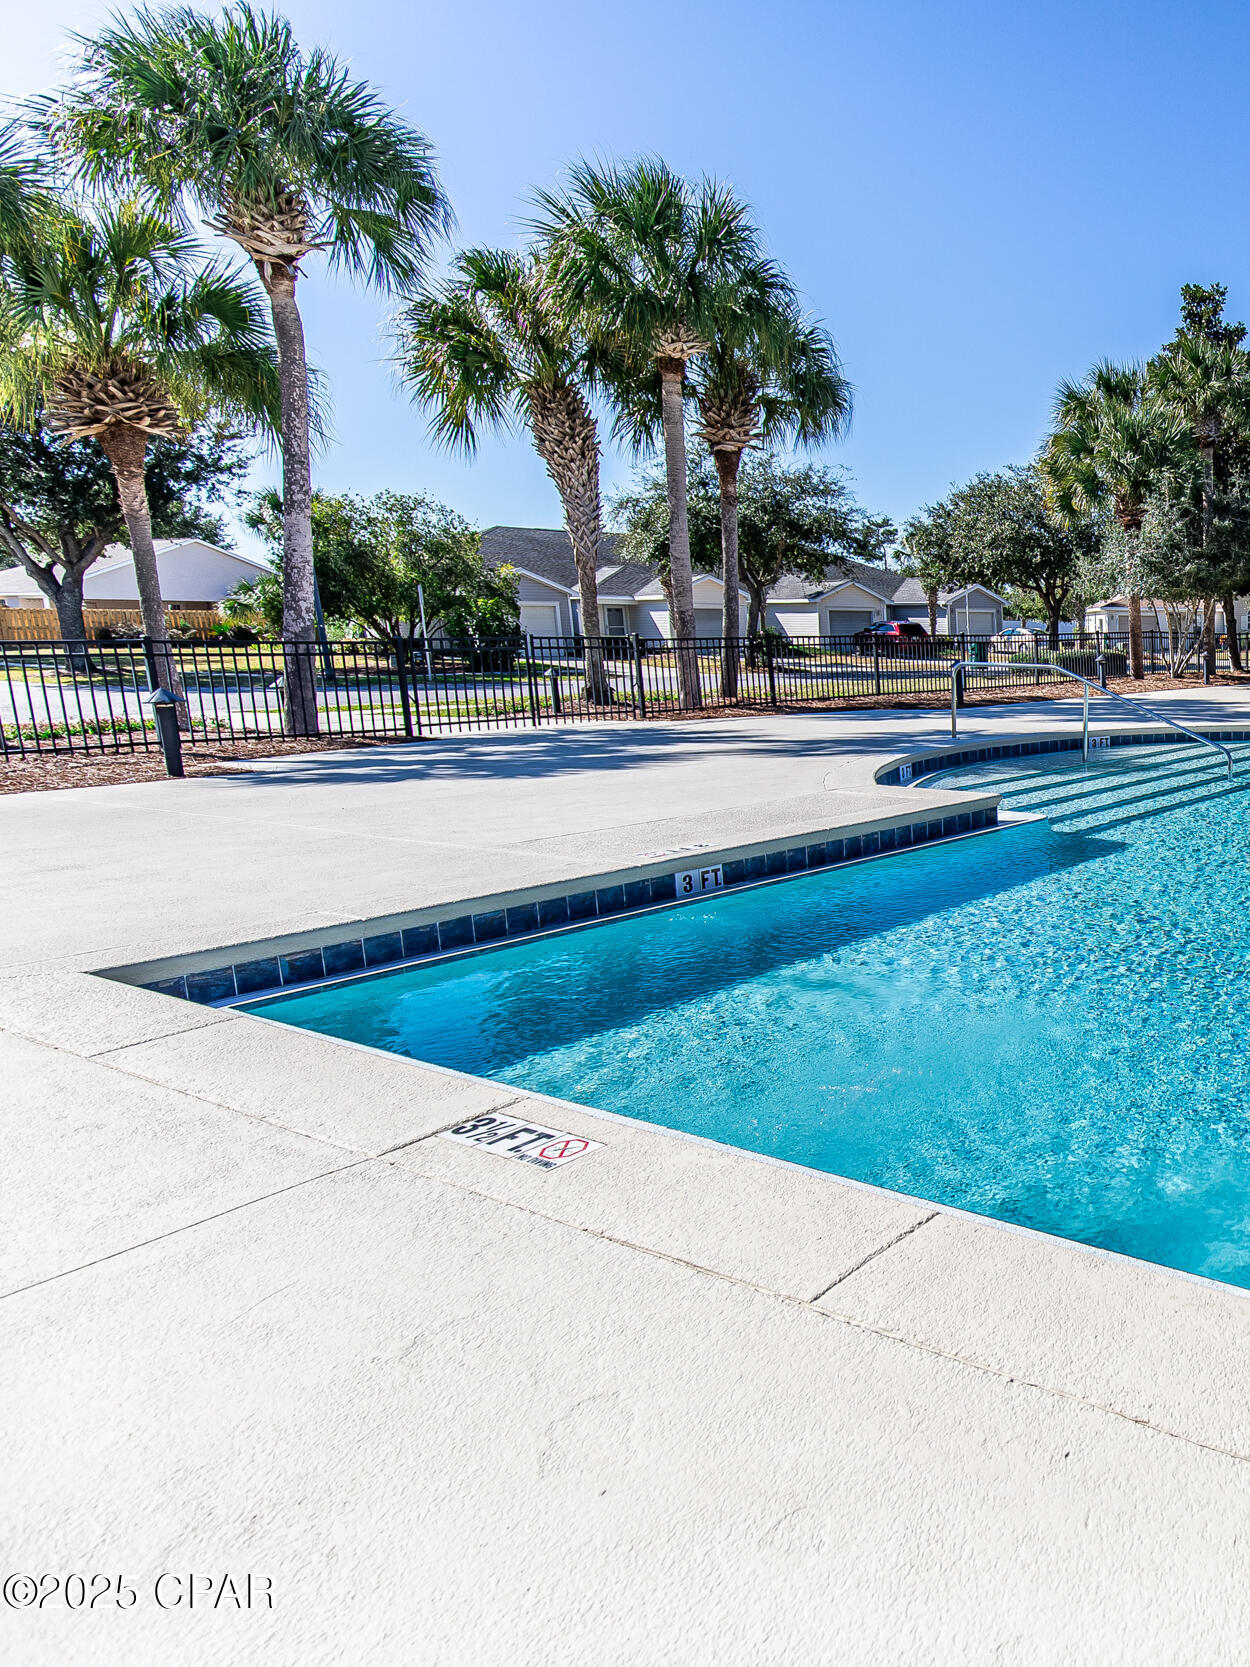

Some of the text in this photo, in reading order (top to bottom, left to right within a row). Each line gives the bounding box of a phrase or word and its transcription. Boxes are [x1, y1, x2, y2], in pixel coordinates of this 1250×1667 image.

[1091, 738, 1097, 748] 3
[682, 868, 722, 893] 3 FT.
[485, 1128, 556, 1153] FT.
